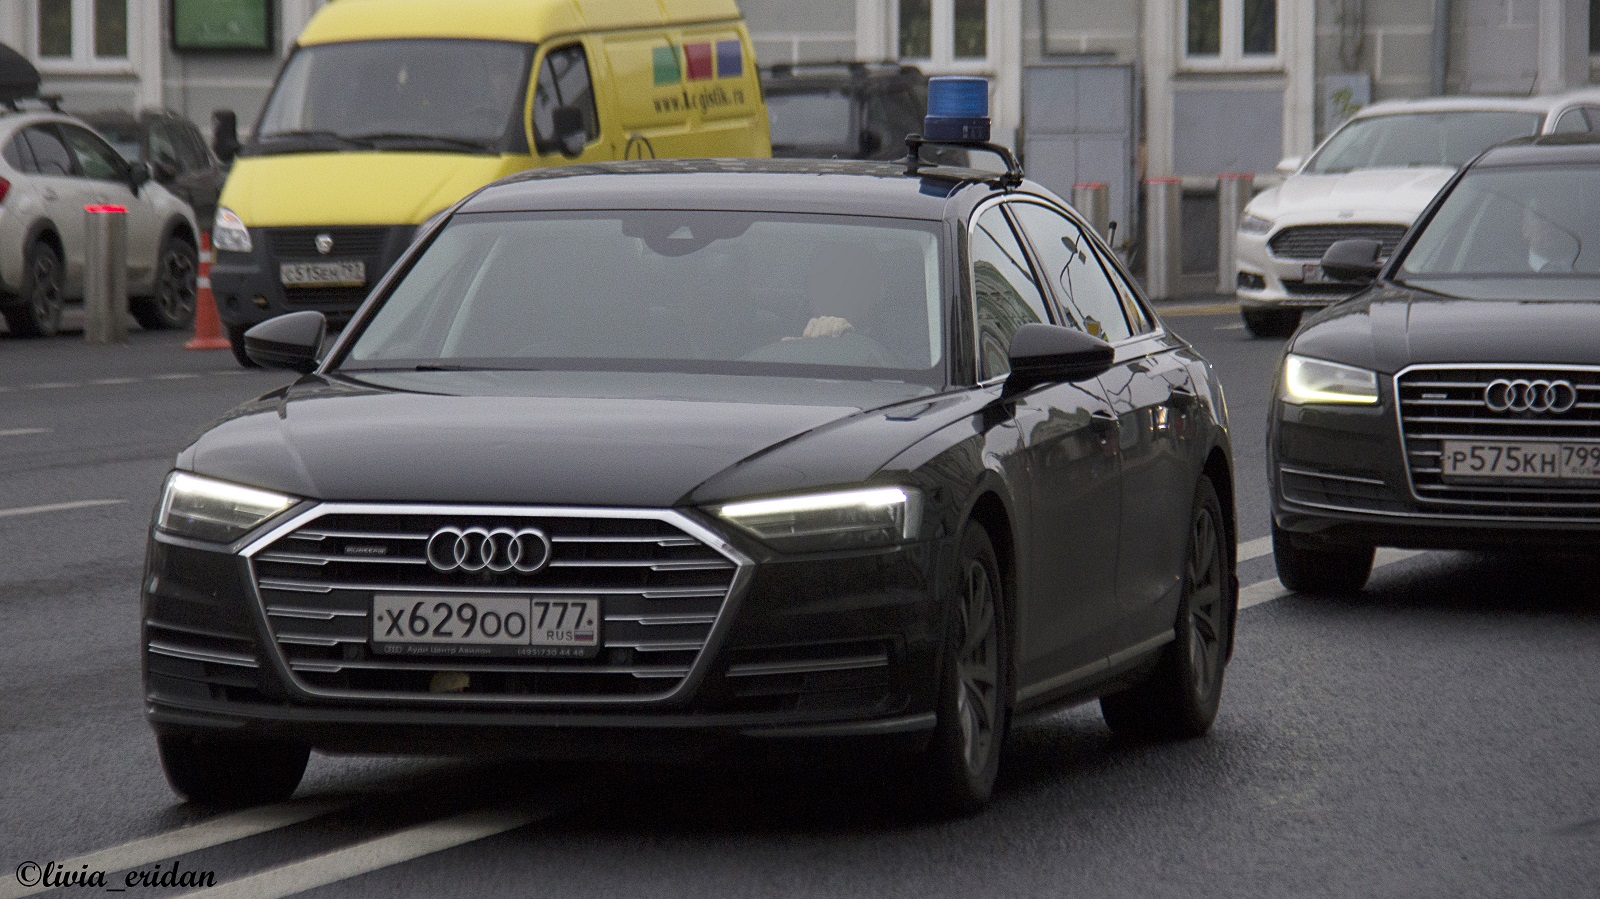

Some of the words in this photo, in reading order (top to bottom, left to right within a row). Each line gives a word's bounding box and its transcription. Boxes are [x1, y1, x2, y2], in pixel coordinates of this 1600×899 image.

[534, 601, 588, 630] 777
[546, 630, 573, 642] RUS
[430, 646, 457, 656] Центр
